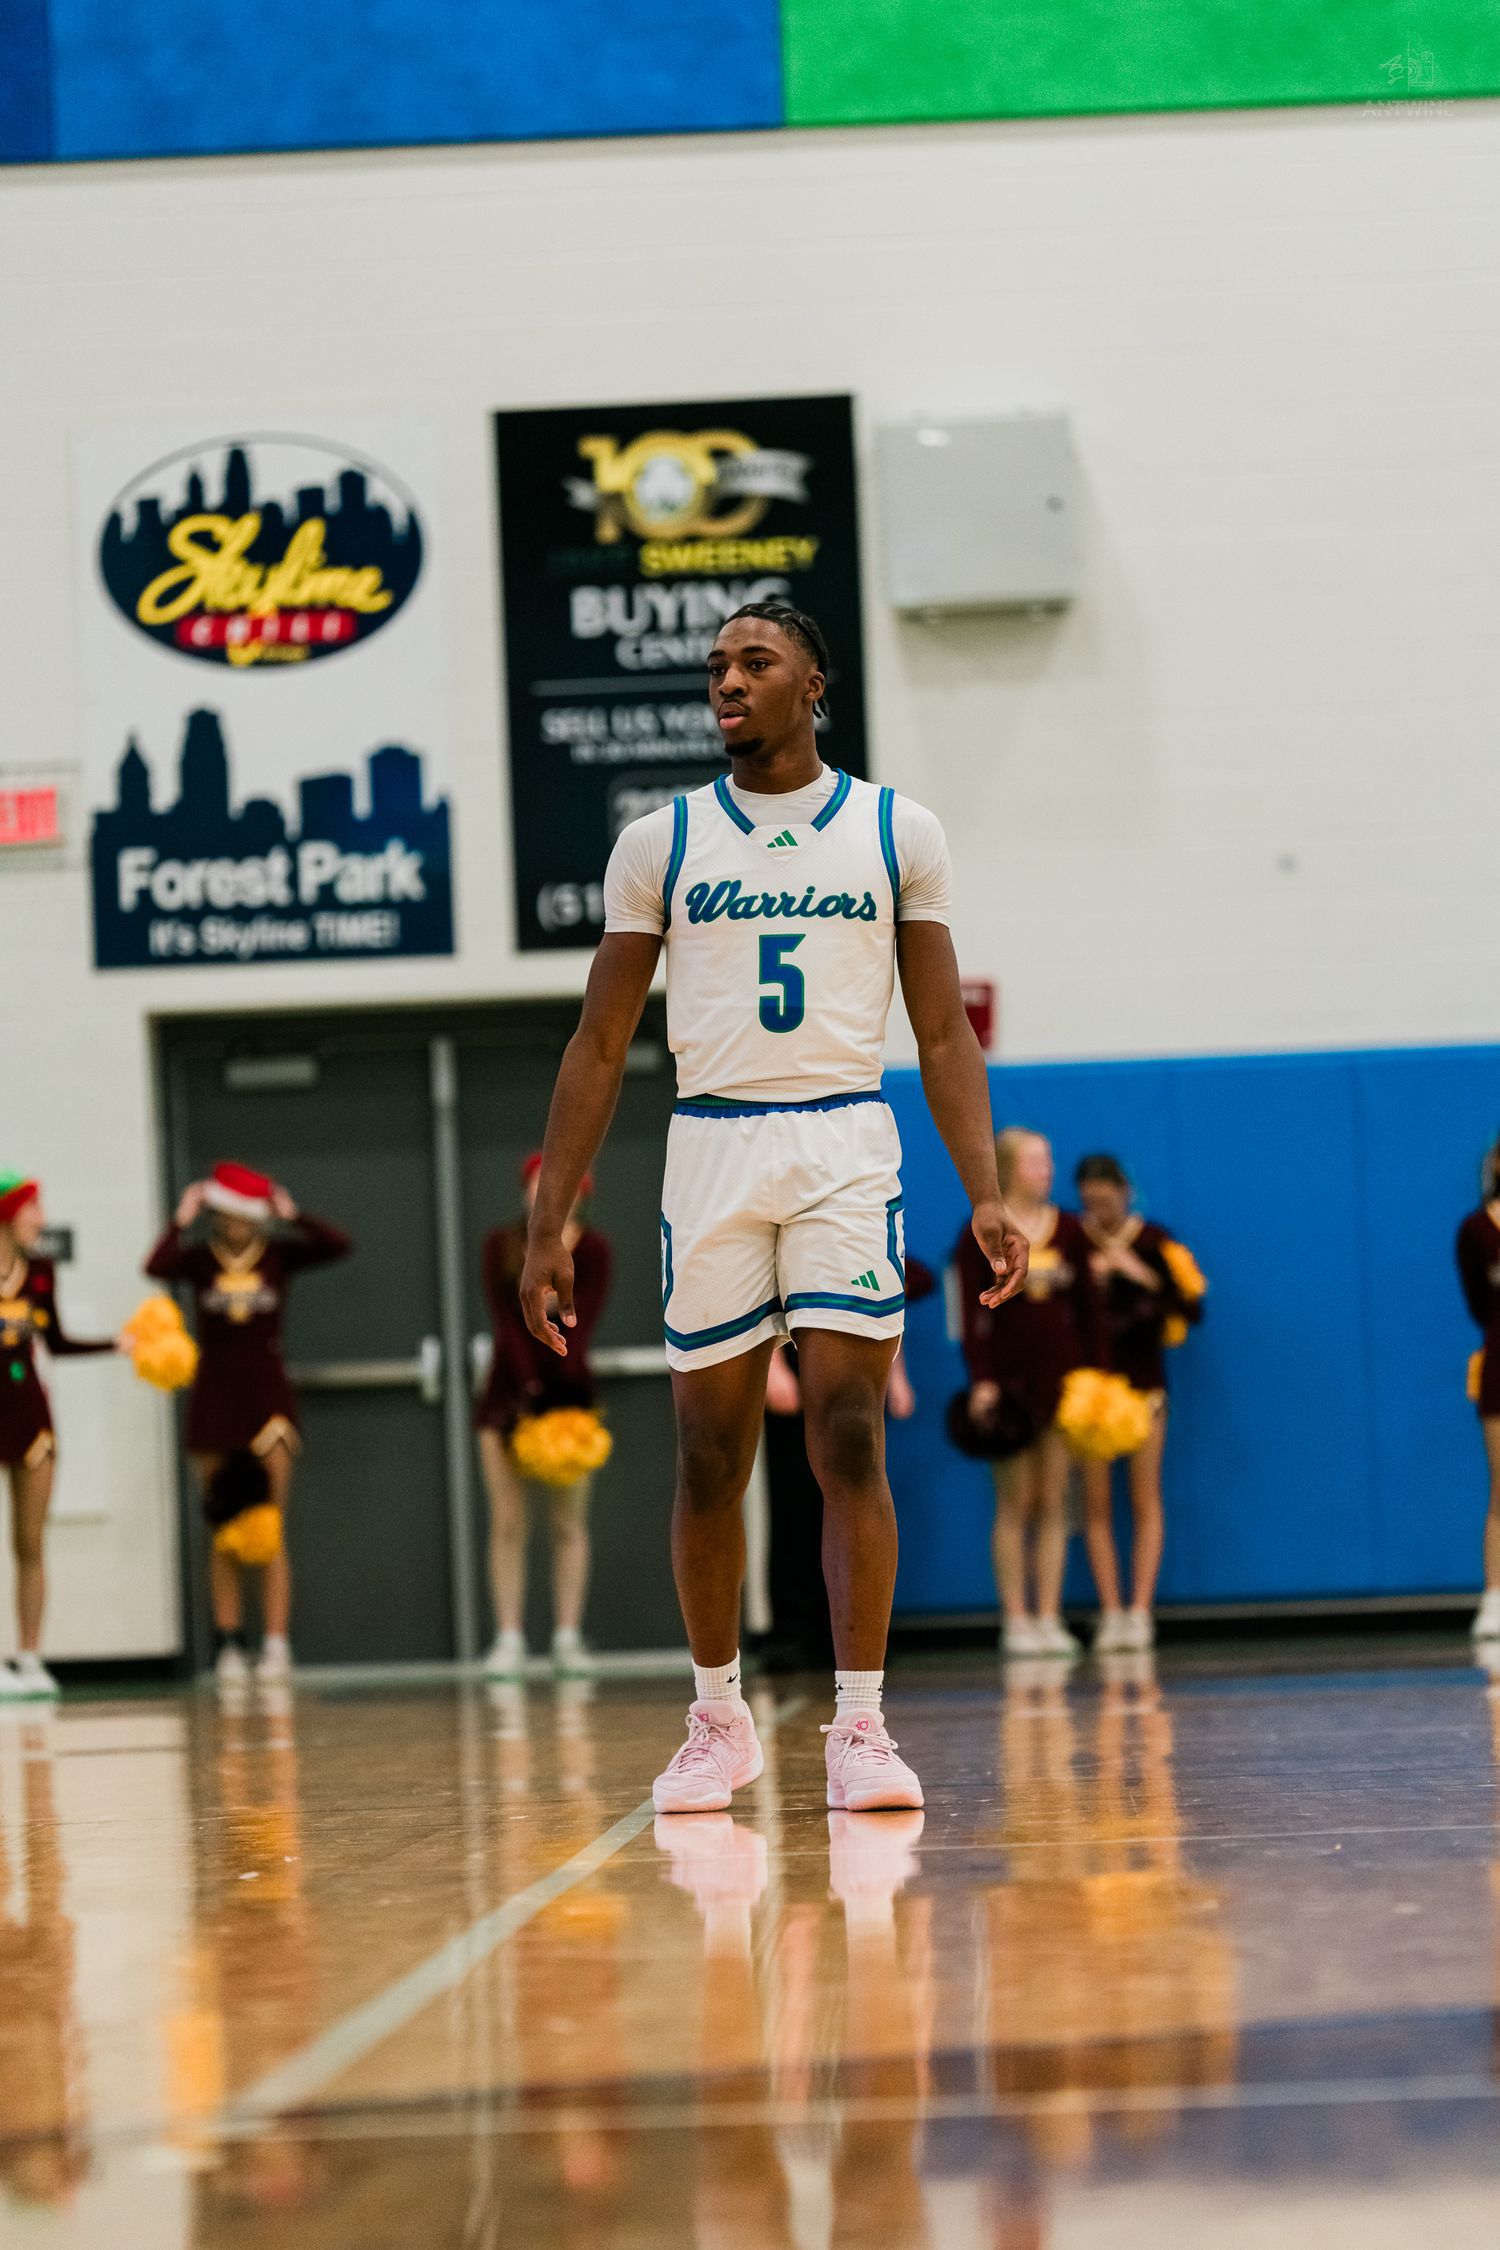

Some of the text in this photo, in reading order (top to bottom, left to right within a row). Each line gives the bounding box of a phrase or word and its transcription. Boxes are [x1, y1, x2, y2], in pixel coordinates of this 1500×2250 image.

[640, 535, 818, 577] SWEENEY
[137, 512, 393, 668] Skyline
[117, 839, 426, 912] Forest Park
[685, 879, 878, 925] Warriors
[199, 913, 310, 961] Skyline
[758, 933, 807, 1034] 5
